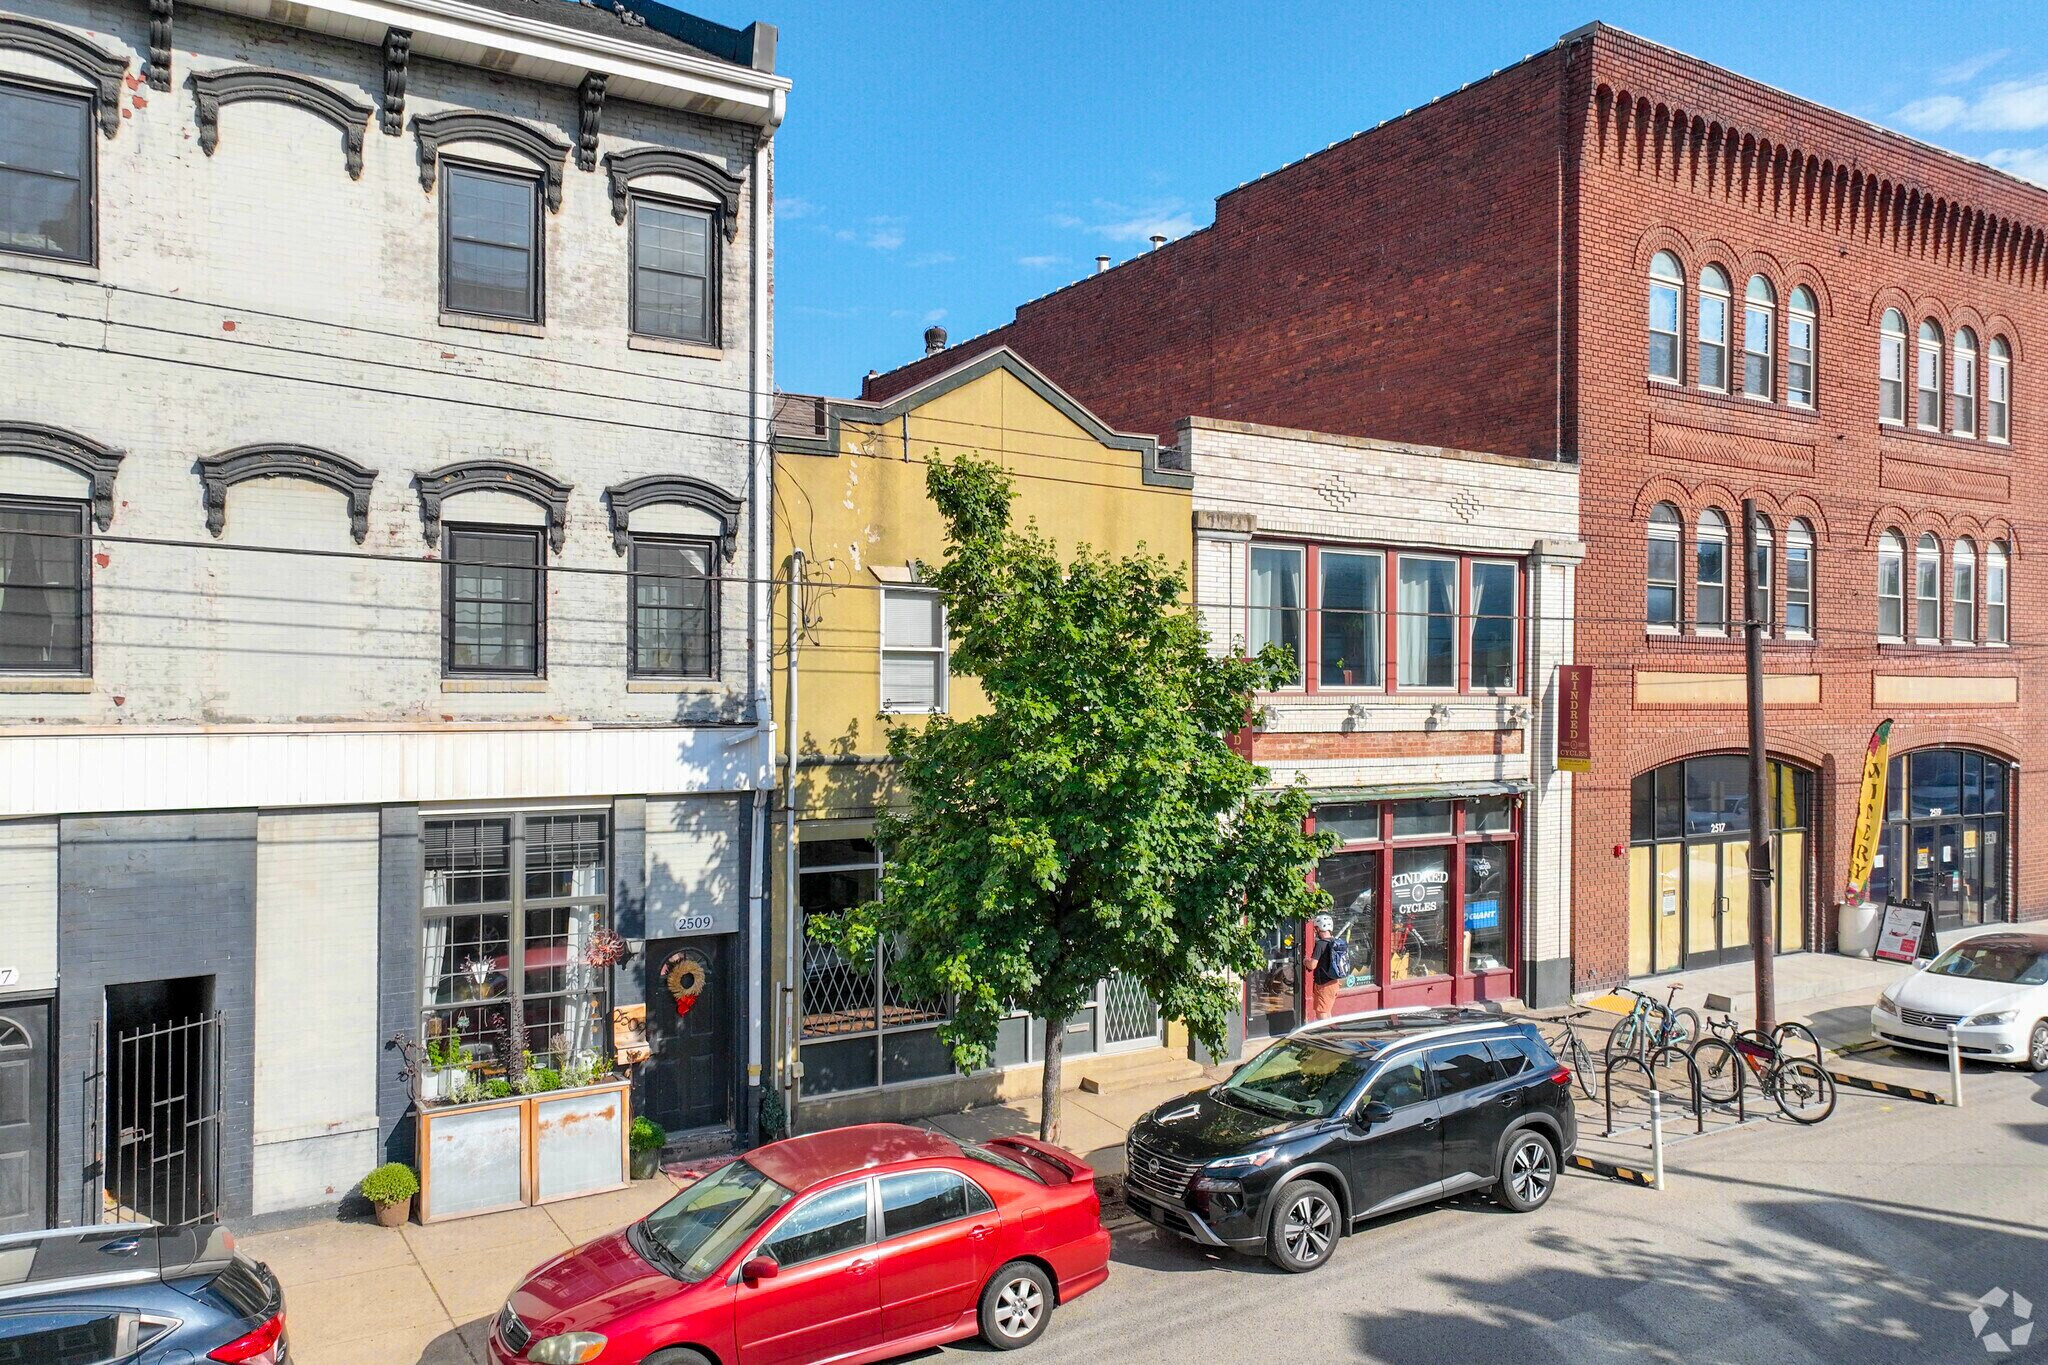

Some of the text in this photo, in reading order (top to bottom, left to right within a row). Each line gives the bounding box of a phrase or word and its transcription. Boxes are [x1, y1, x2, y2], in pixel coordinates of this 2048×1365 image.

[1570, 671, 1580, 739] KINDRED
[1560, 749, 1588, 757] CYCLES
[1710, 822, 1726, 833] 2517
[1391, 871, 1449, 888] KINDRED
[1399, 902, 1437, 914] CYCLES
[678, 916, 711, 930] 2509
